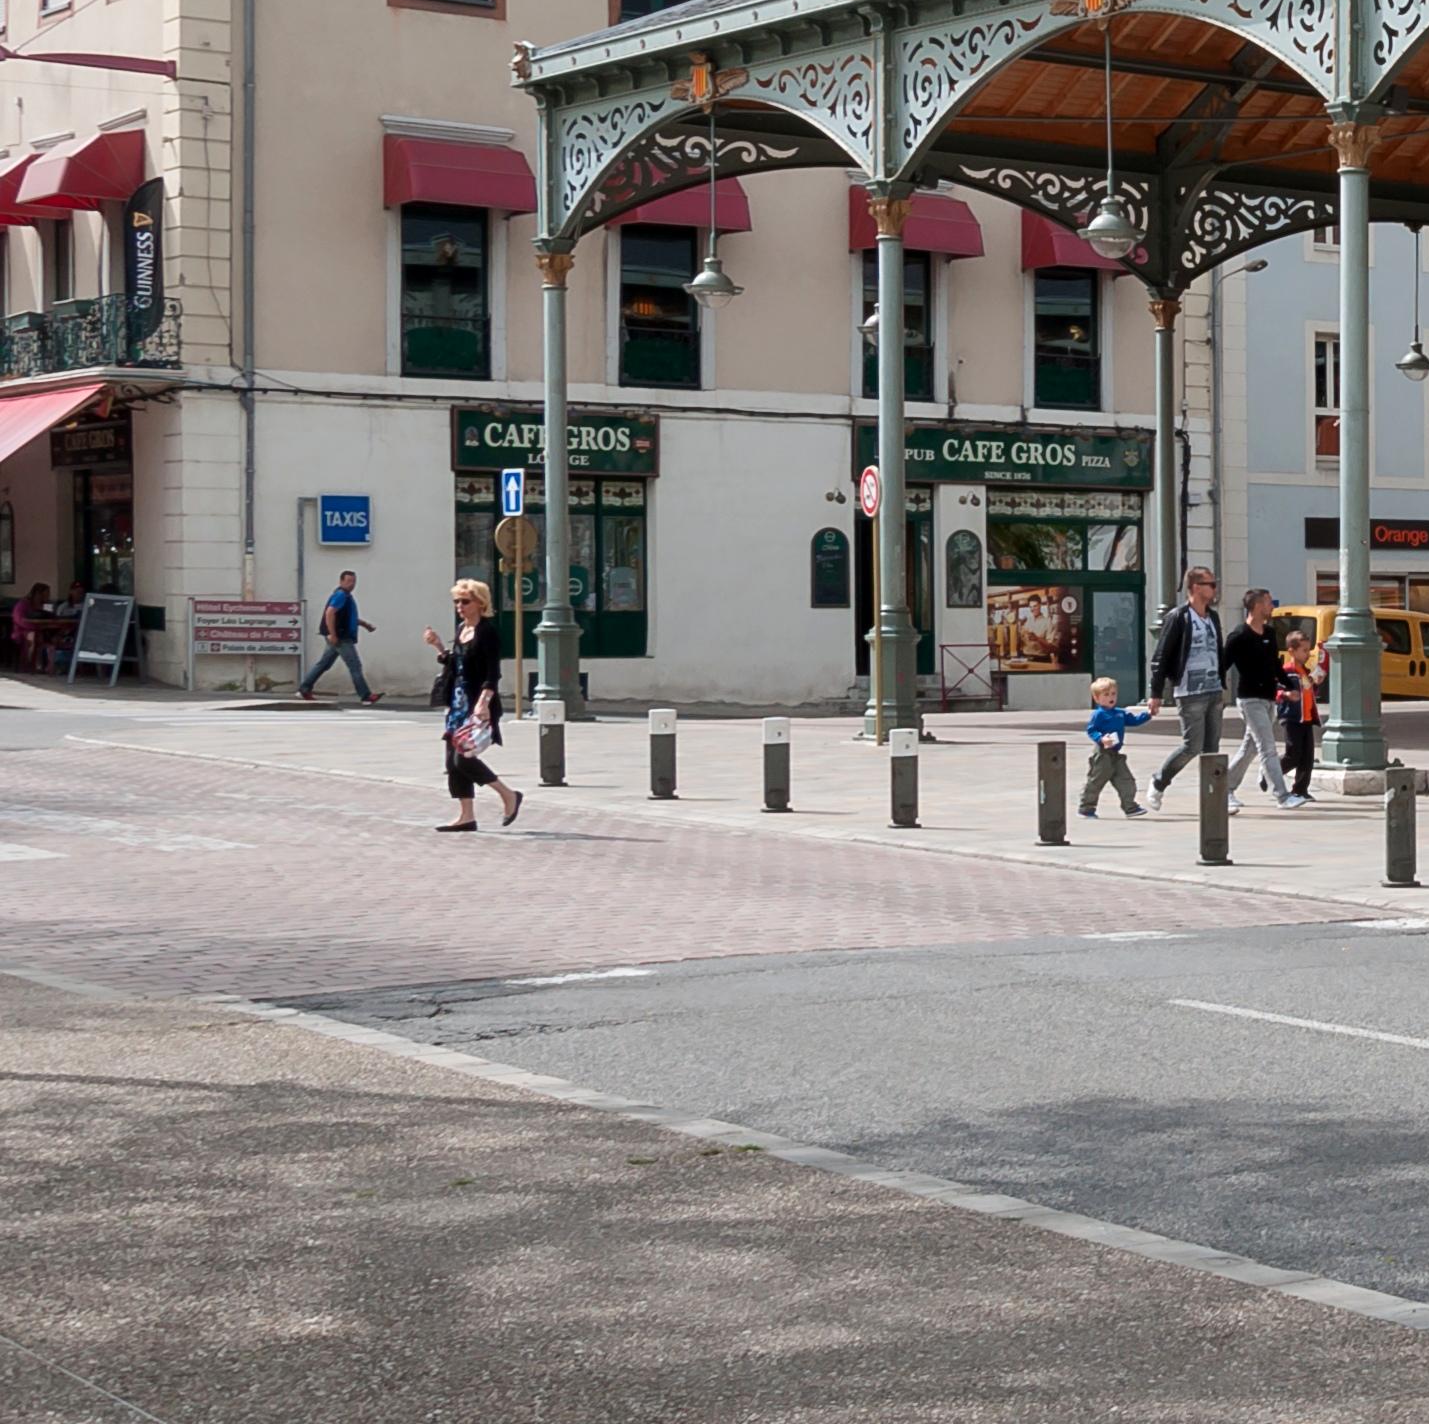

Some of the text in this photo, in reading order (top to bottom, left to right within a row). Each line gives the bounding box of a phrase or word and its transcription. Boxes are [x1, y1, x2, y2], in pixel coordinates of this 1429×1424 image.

[133, 231, 155, 309] GUINNESS
[566, 425, 631, 452] GROS
[528, 452, 590, 466] LOGE
[904, 438, 1111, 469] PUB CAFE GROS PIZZA
[324, 511, 368, 528] TAXIS
[1374, 525, 1429, 547] Orange
[196, 603, 221, 611] Hôtel
[197, 617, 277, 626] Foyer Léo Lagrange
[209, 629, 282, 639] Château de Foix
[222, 643, 285, 652] Palais de Justice
